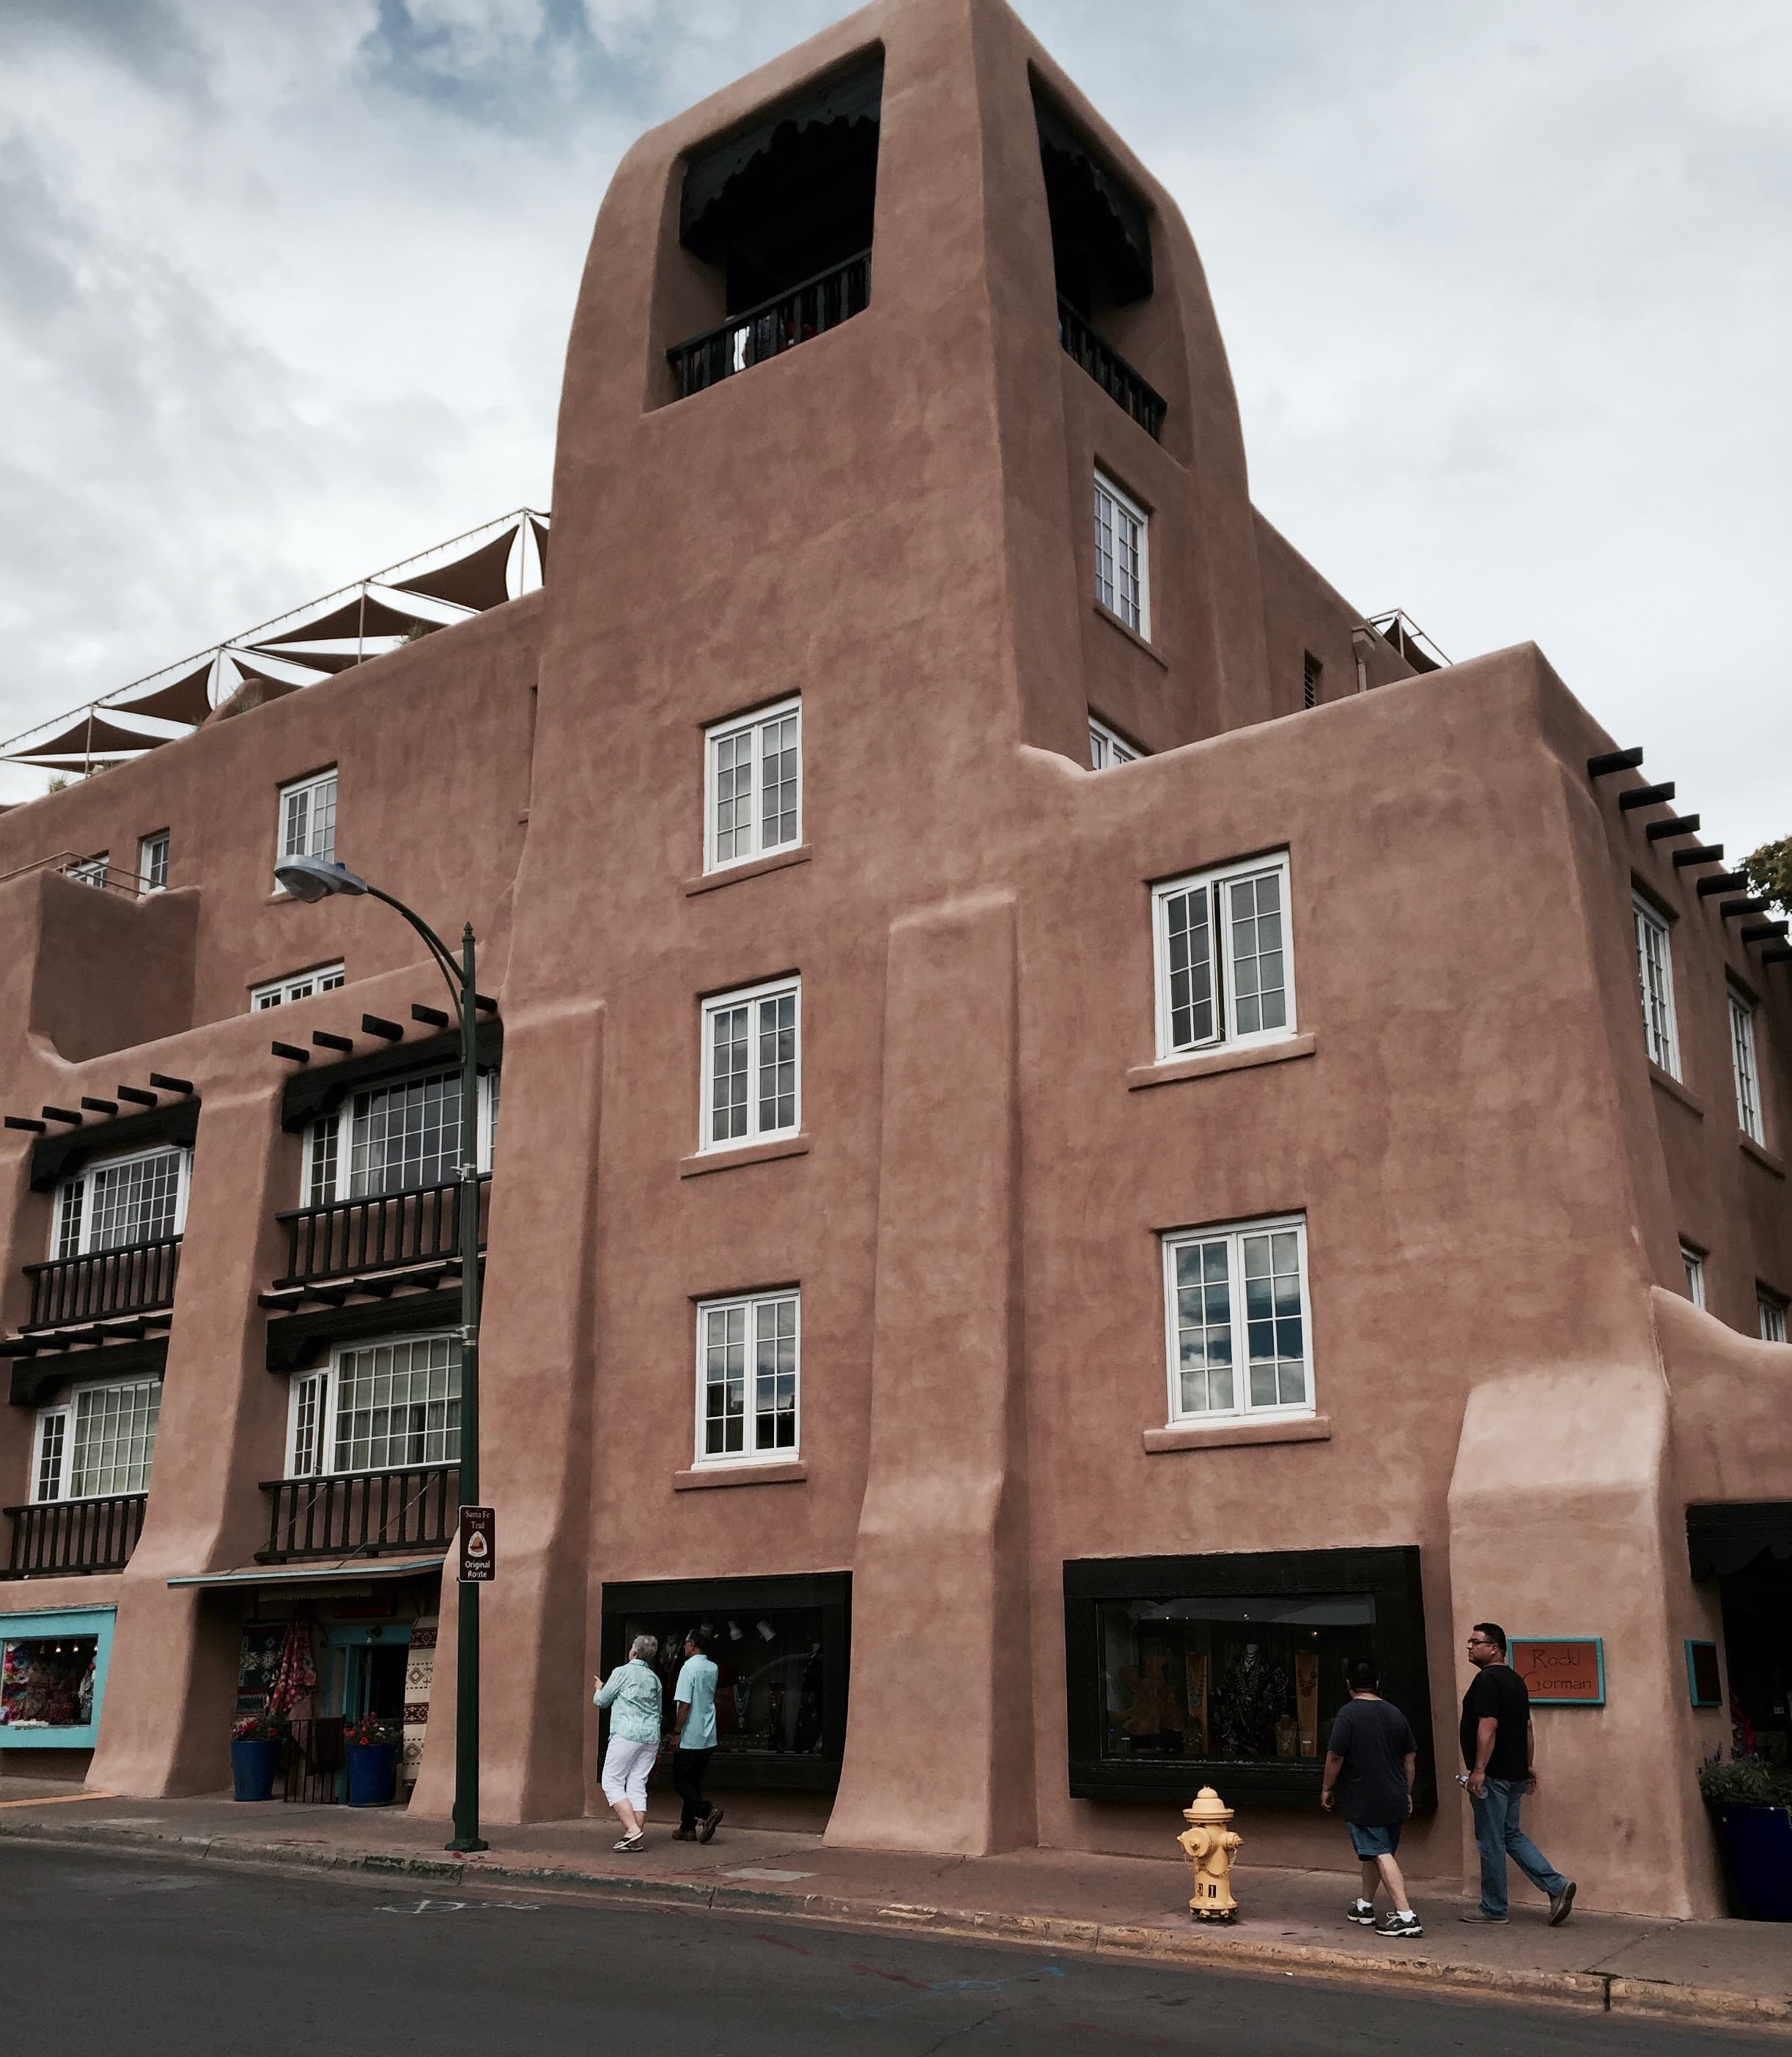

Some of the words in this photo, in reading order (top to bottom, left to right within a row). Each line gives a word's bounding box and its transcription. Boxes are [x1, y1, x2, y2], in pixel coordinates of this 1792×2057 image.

[465, 1510, 482, 1518] Santa
[471, 1521, 485, 1529] Trail
[465, 1560, 490, 1570] Original
[468, 1570, 487, 1578] Route
[1532, 1648, 1582, 1668] Rocki
[1523, 1671, 1592, 1692] Gorman
